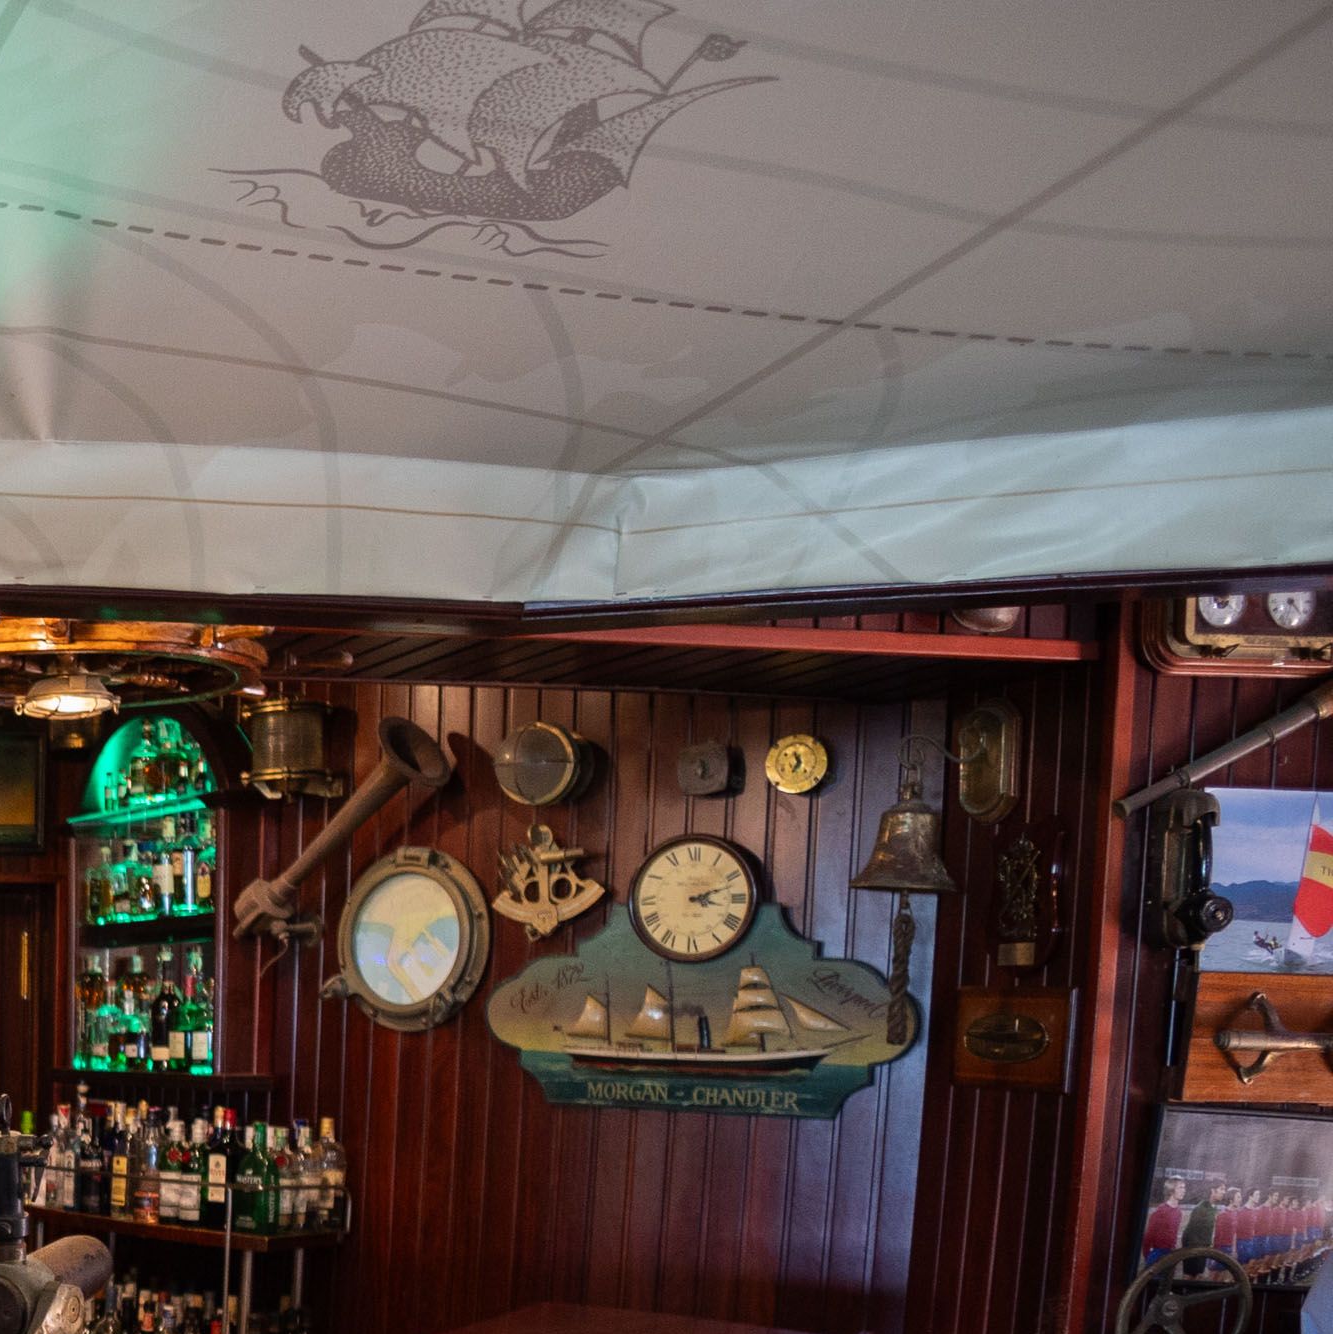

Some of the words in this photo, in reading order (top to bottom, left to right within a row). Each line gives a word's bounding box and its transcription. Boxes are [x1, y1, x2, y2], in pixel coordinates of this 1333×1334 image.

[554, 961, 595, 990] 1872
[585, 1079, 669, 1103] MORGAN
[692, 1086, 801, 1112] CHANDLER
